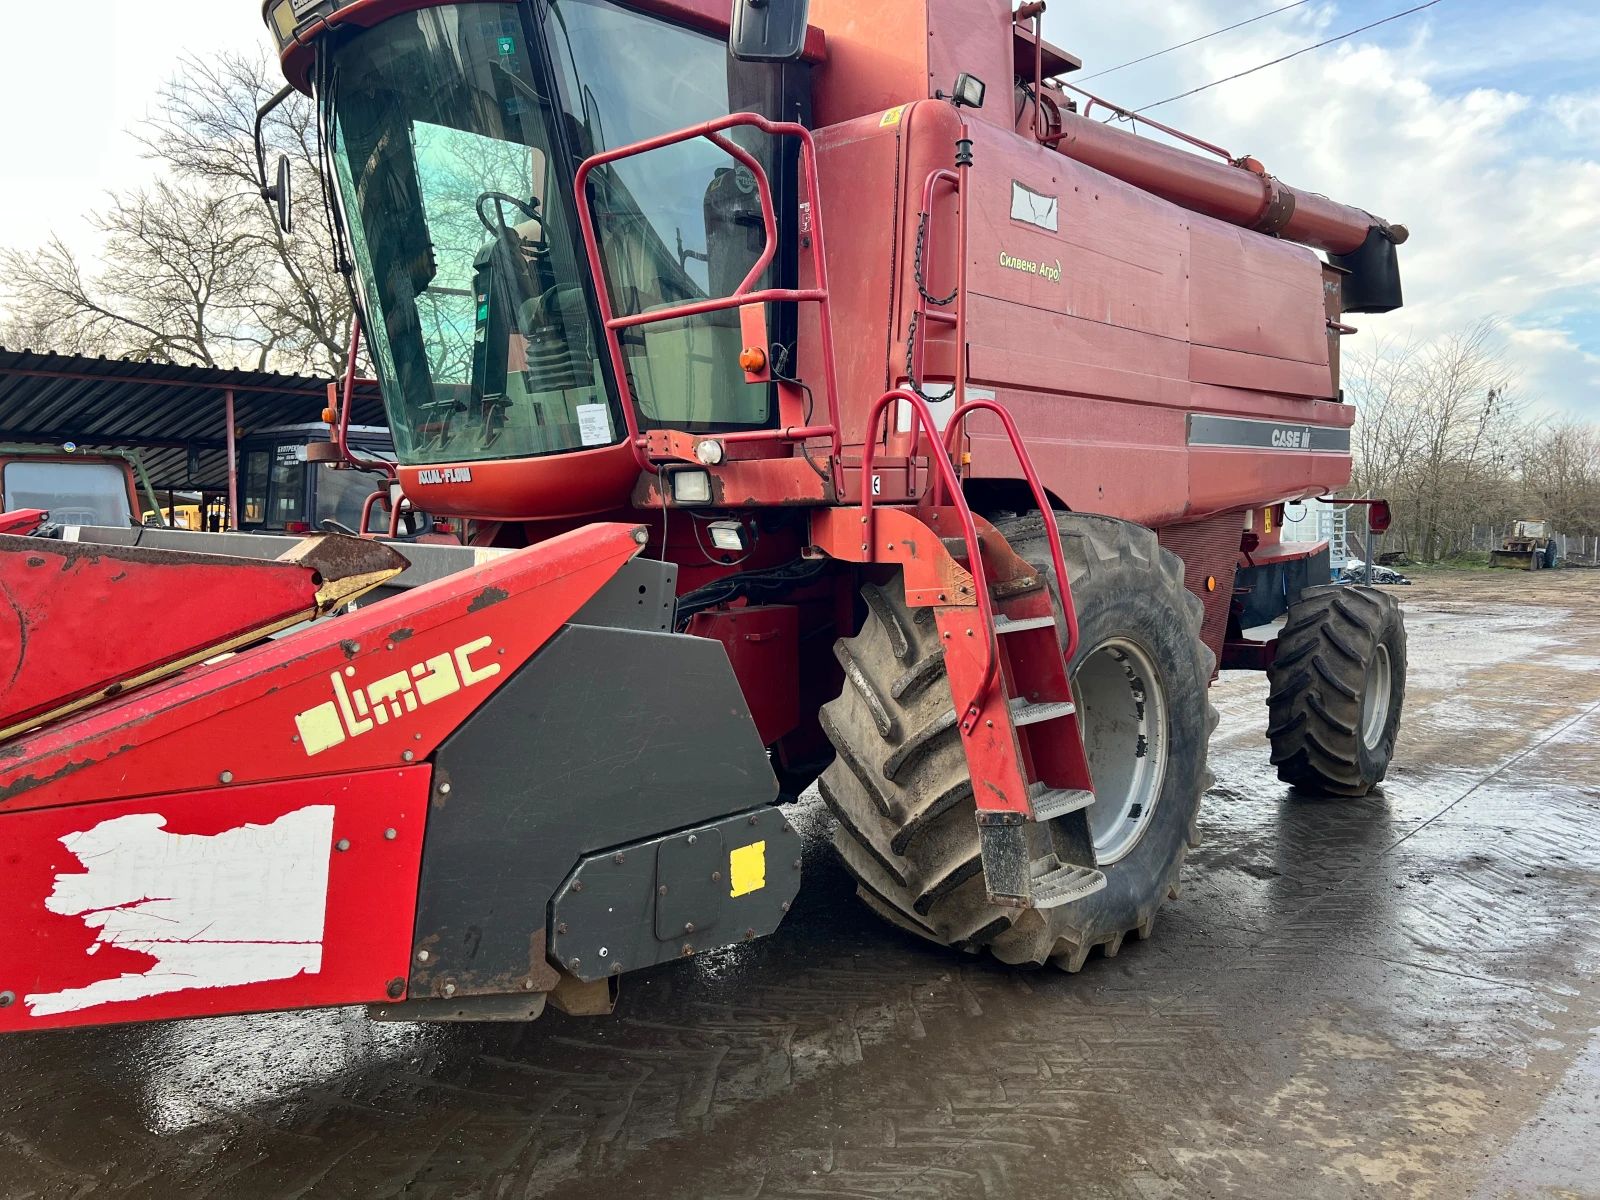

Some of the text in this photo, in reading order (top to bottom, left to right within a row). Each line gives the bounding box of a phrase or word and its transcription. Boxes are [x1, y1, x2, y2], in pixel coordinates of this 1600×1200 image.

[1000, 251, 1060, 281] Силвена Агро
[1271, 429, 1300, 447] CASE
[418, 467, 471, 484] AXIAL-FLOW
